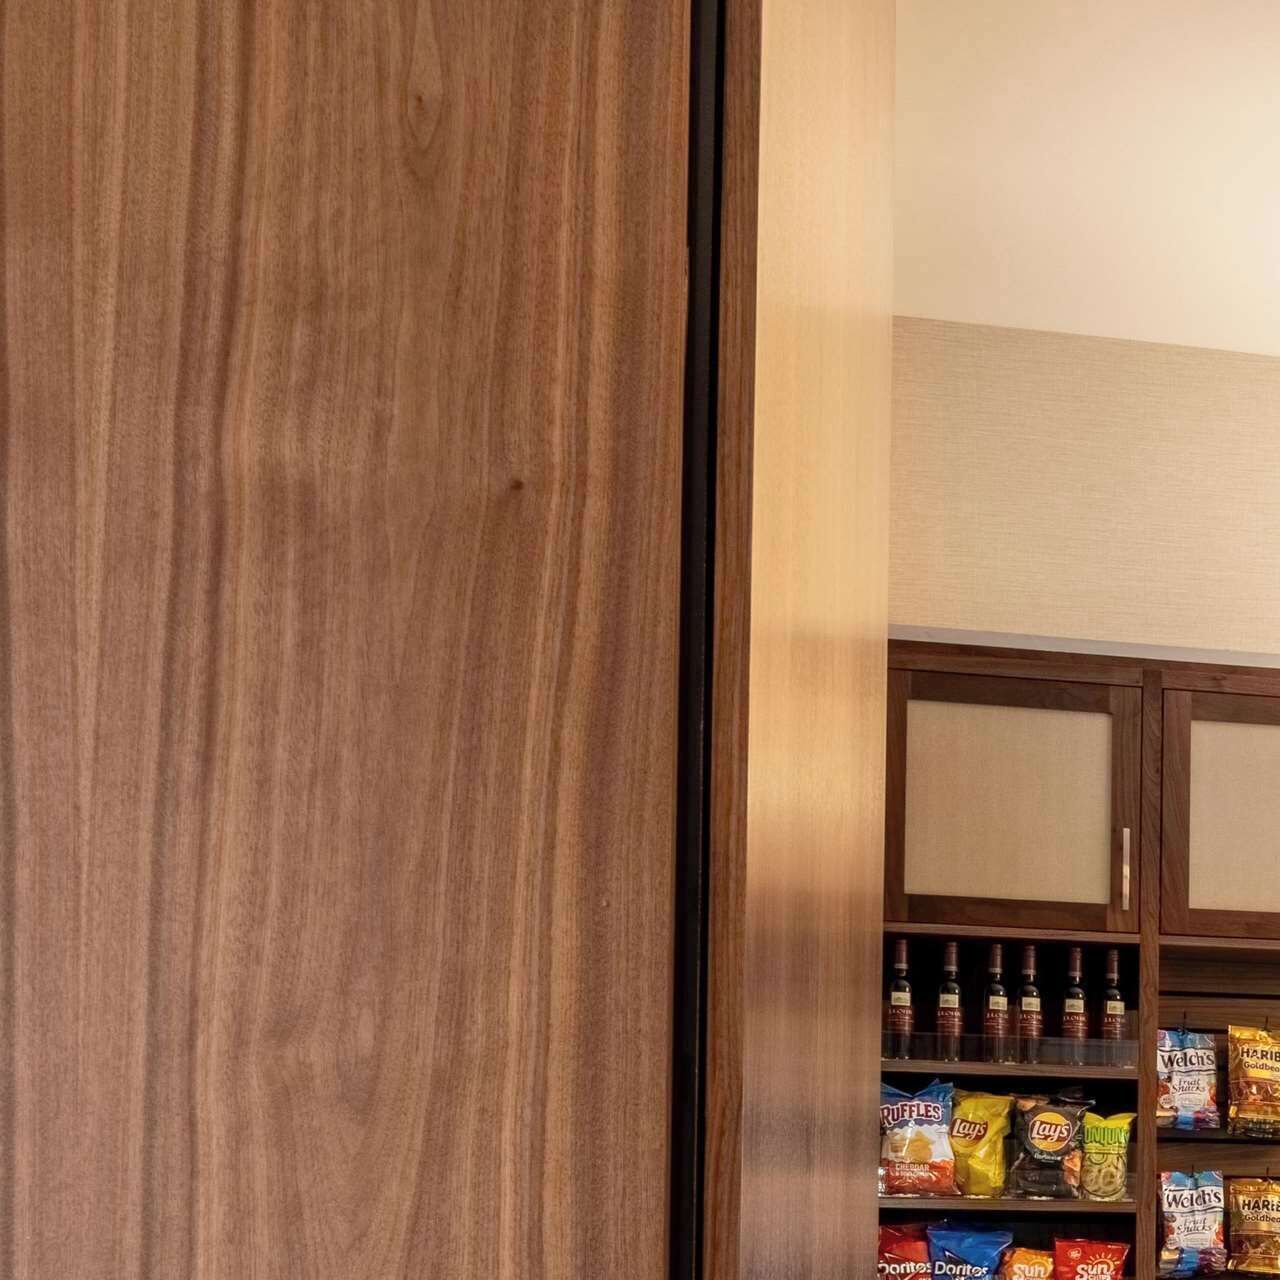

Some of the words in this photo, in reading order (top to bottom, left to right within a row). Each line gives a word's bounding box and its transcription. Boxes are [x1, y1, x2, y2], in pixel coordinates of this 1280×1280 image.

[1160, 1050, 1215, 1068] Welch's
[880, 1101, 942, 1126] RUFFLES
[1165, 1189, 1222, 1210] Welch's
[934, 1261, 989, 1277] Doritos
